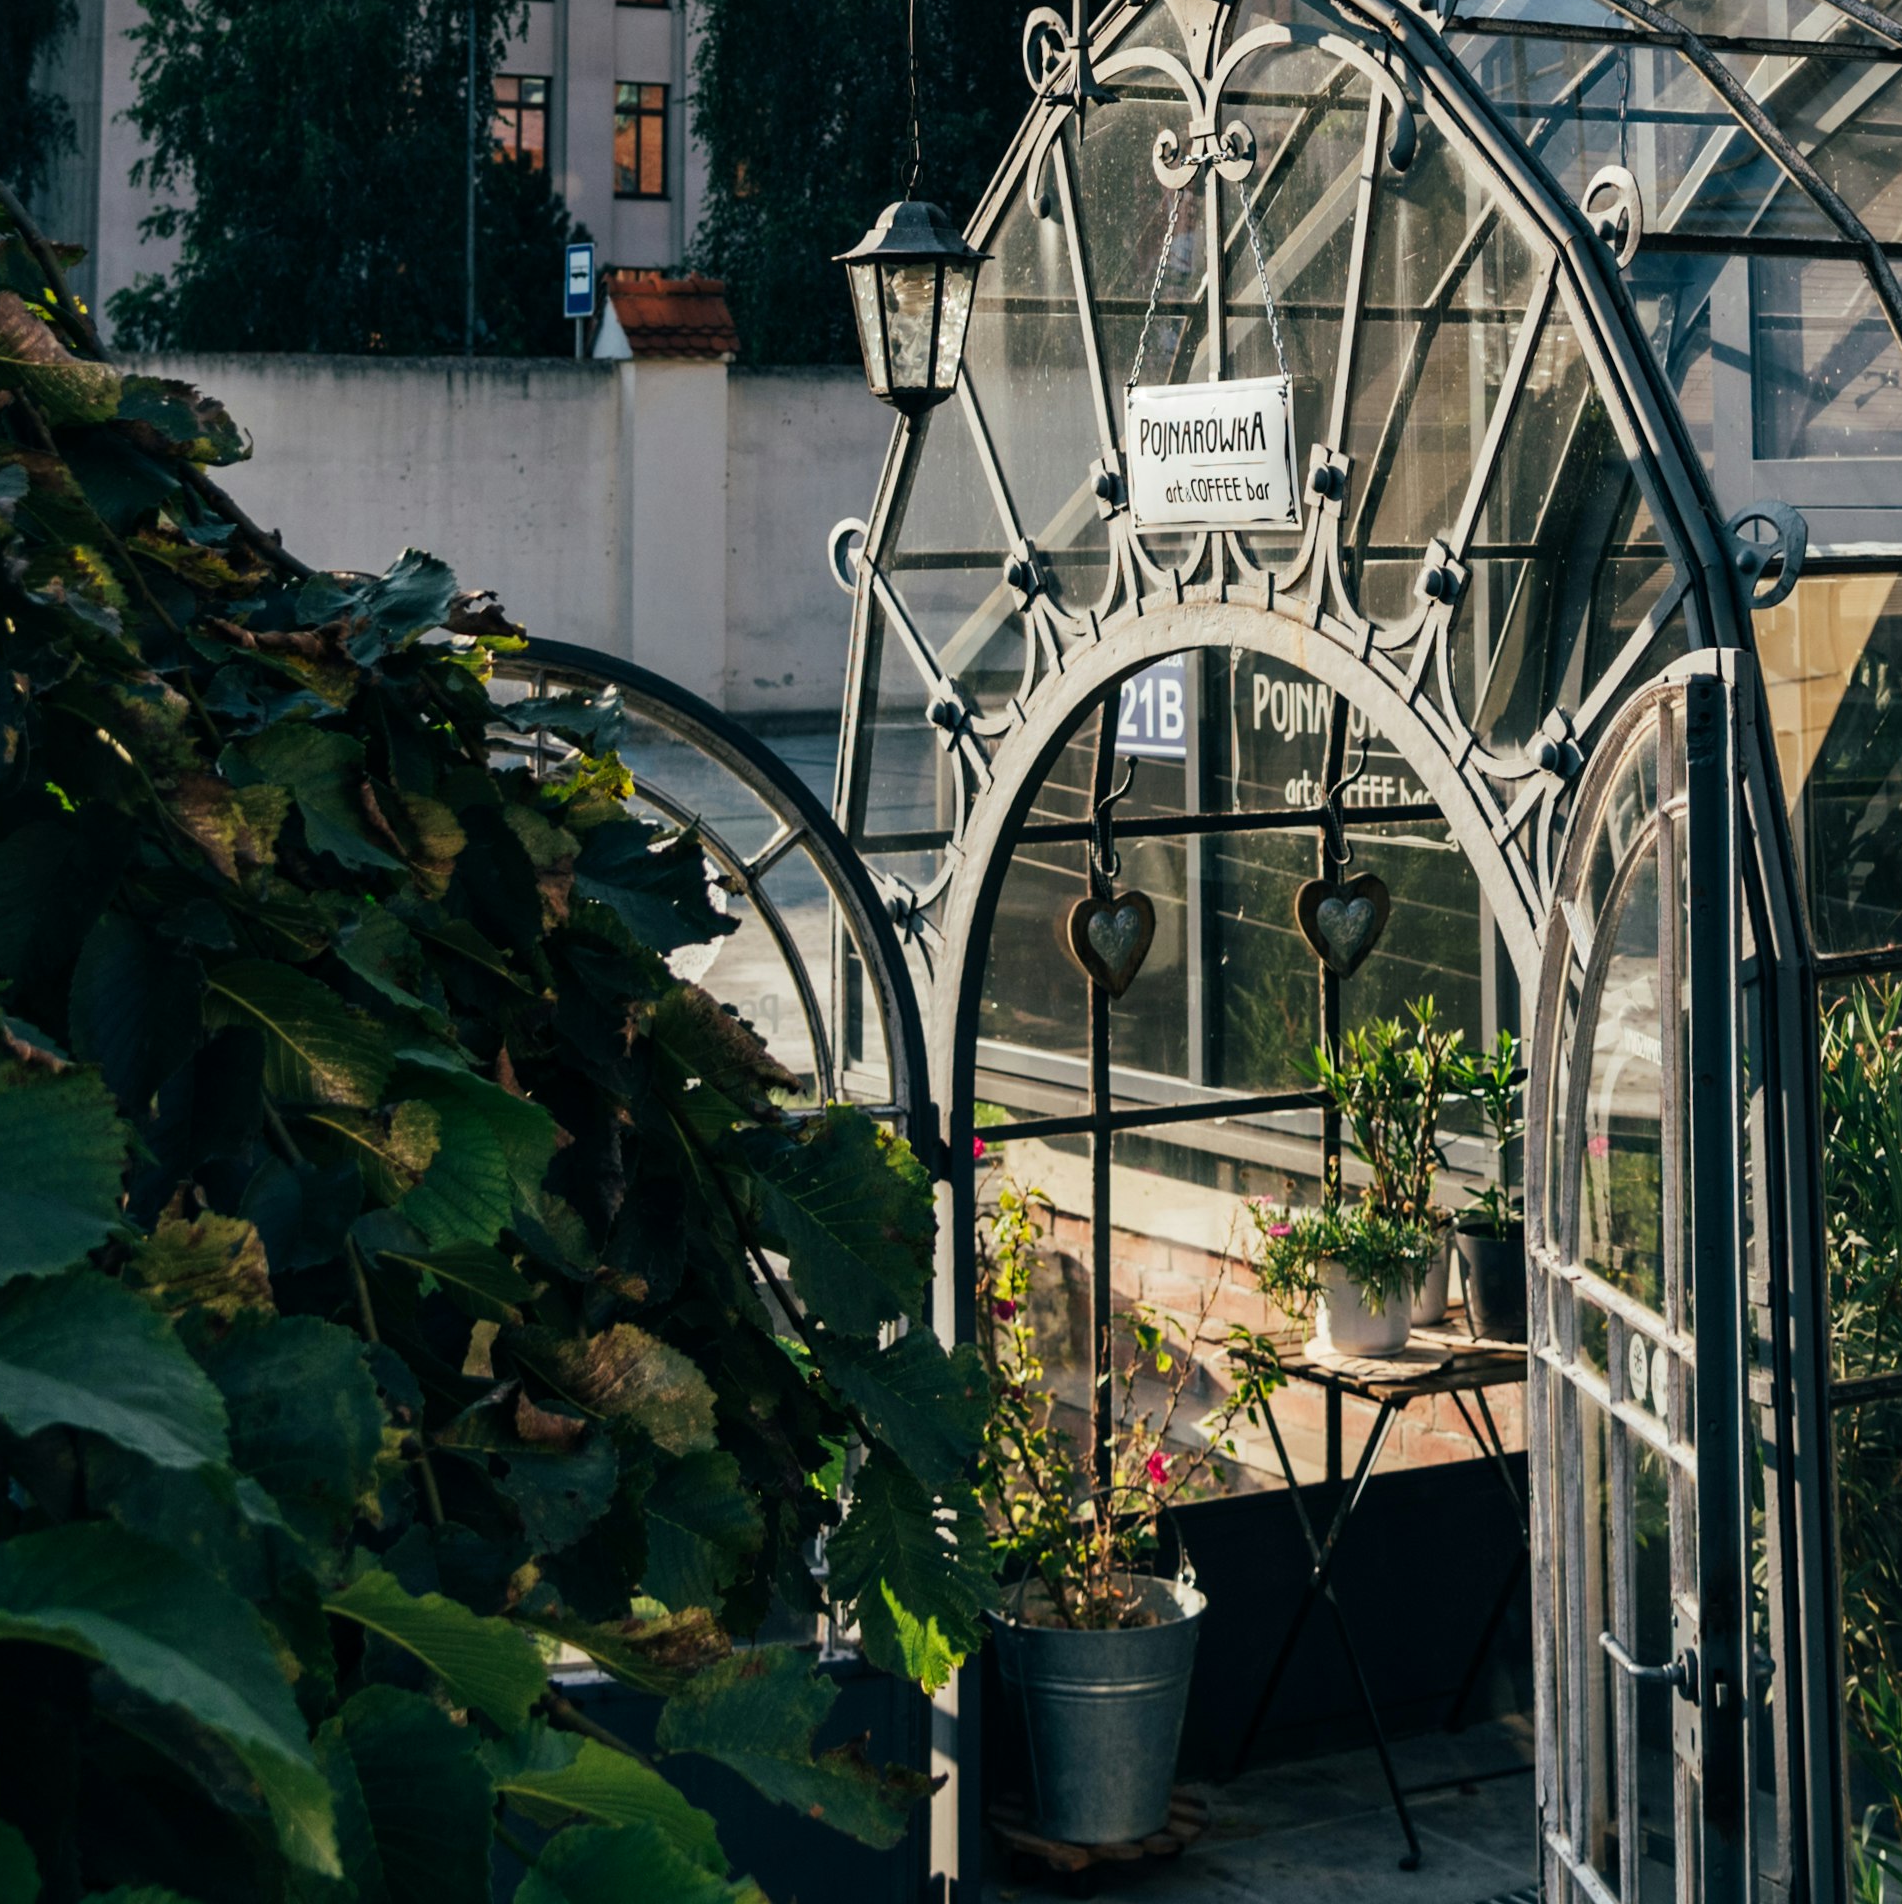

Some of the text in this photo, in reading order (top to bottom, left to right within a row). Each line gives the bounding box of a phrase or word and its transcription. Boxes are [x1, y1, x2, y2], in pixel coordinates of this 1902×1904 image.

[1139, 404, 1267, 463] POJNARÓWKA
[1245, 476, 1270, 501] bar
[1119, 678, 1185, 740] 21B
